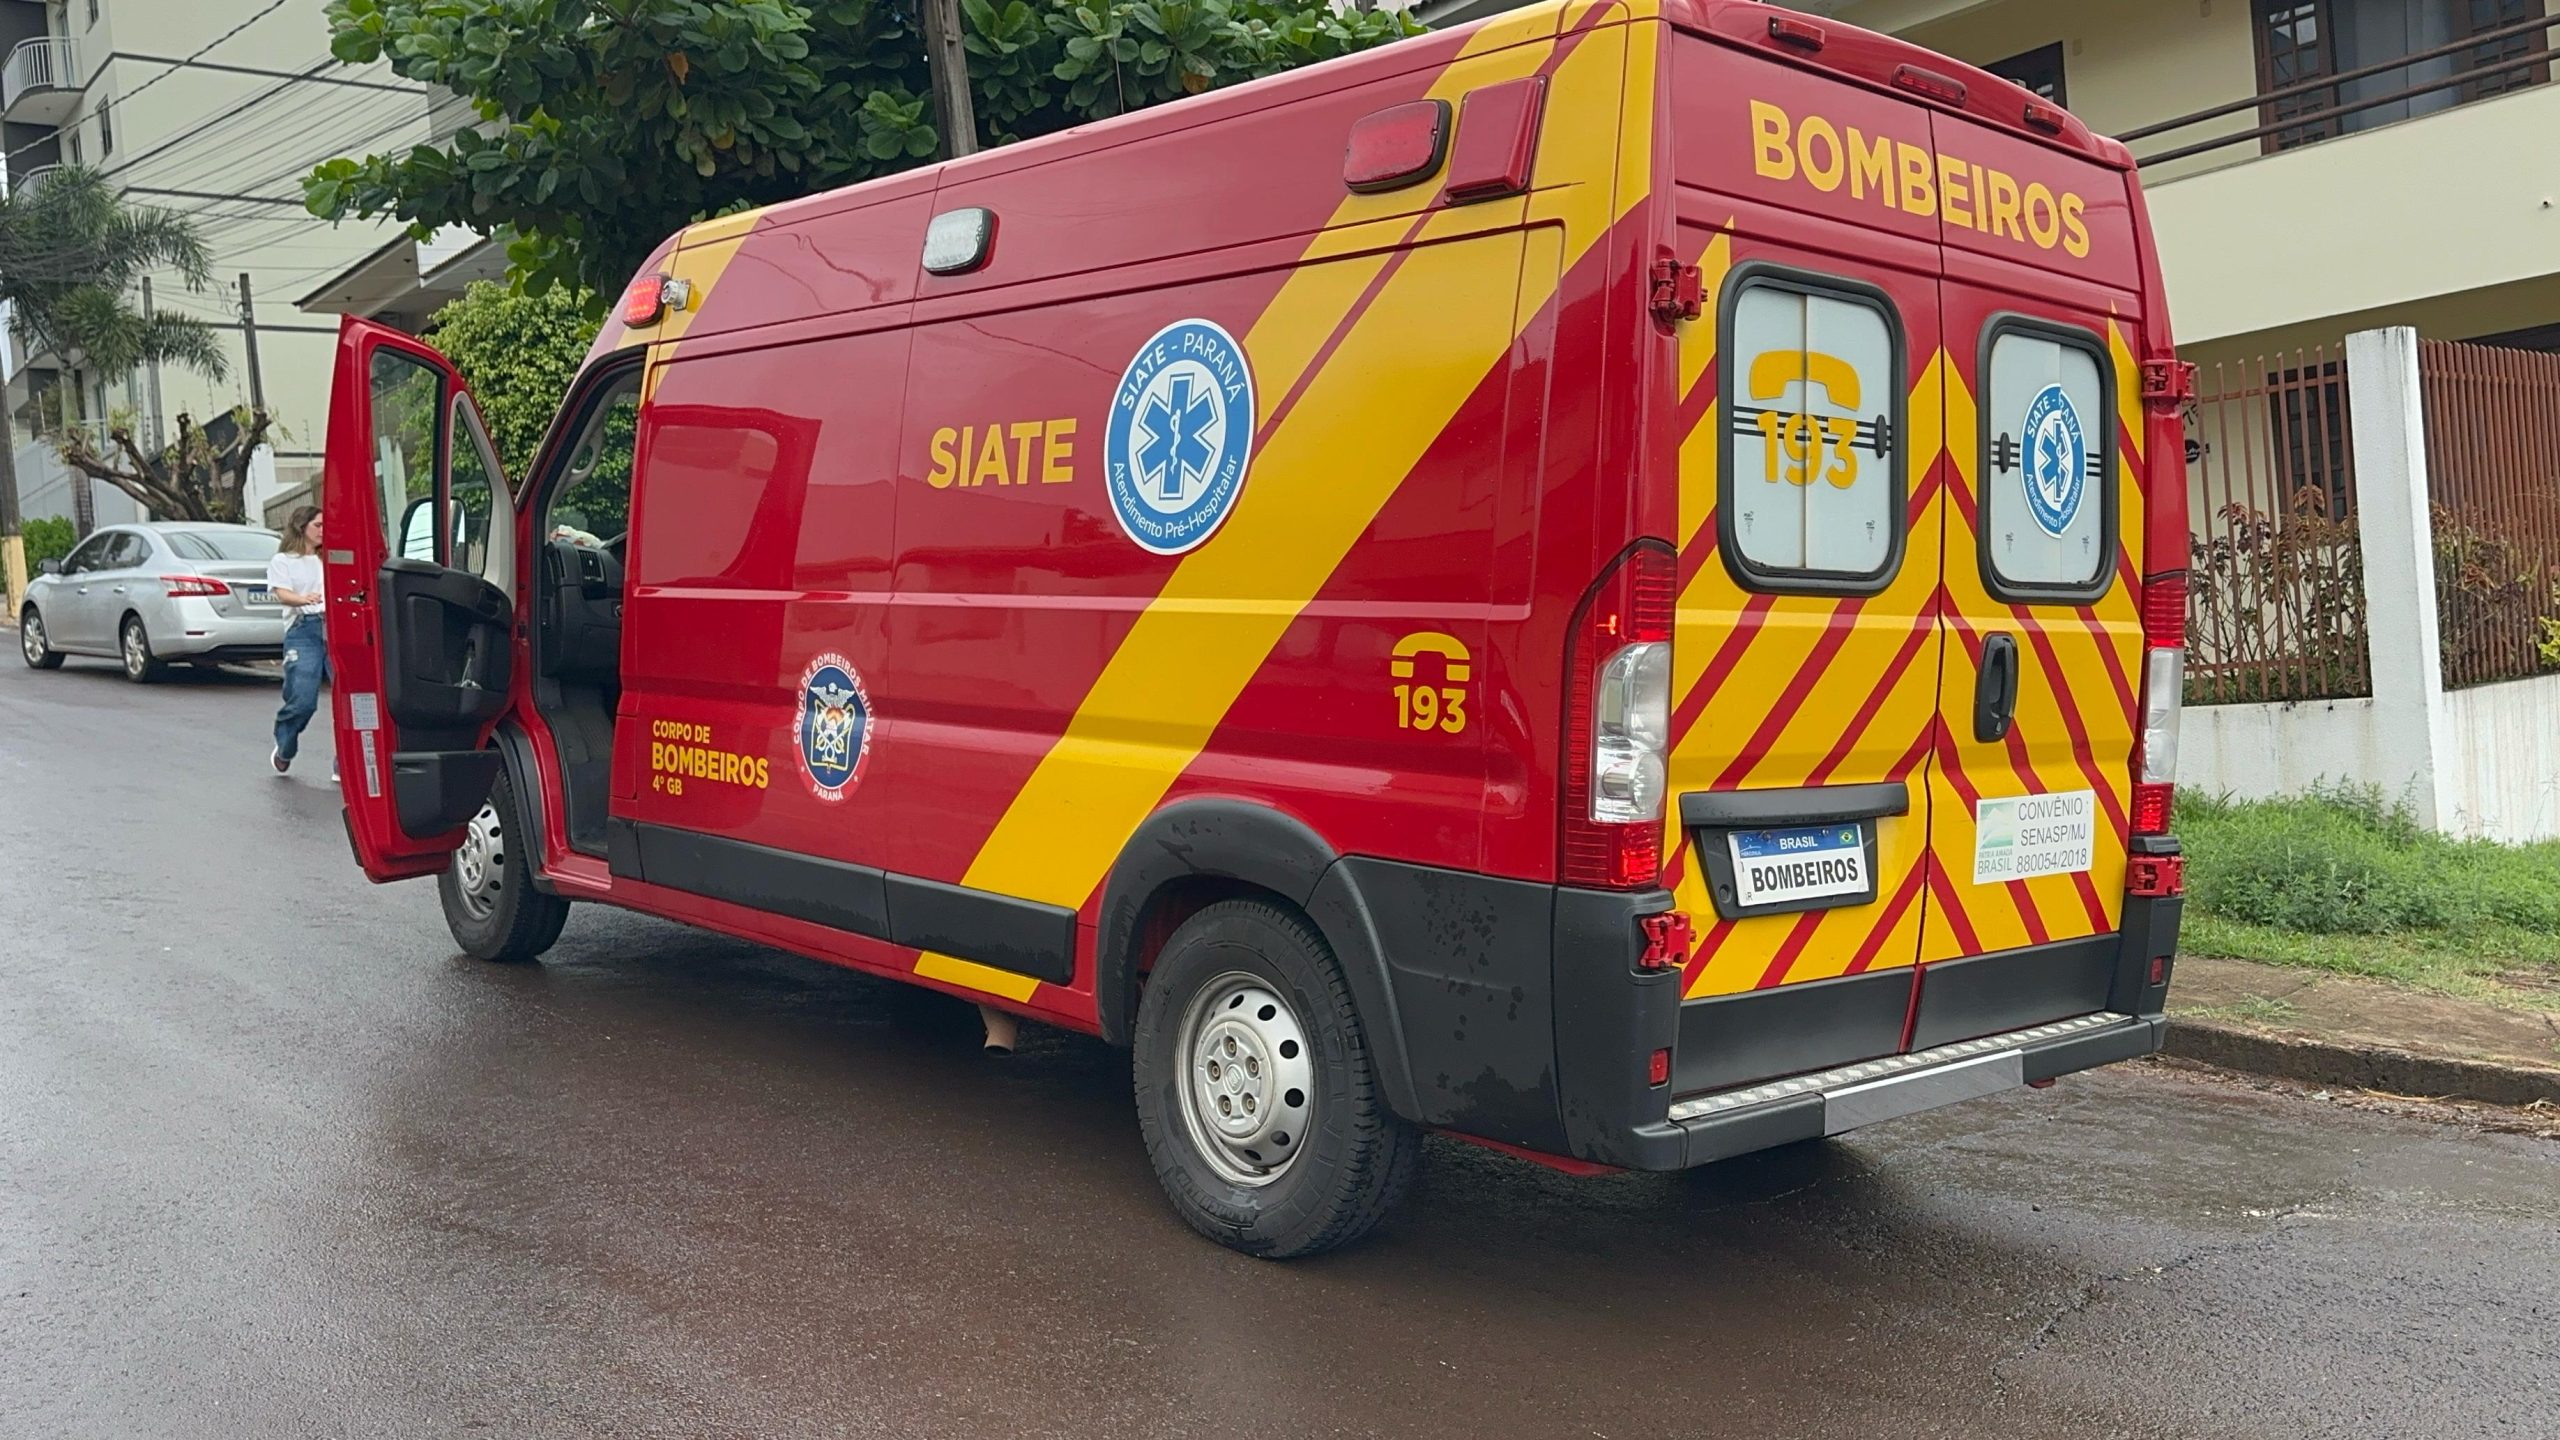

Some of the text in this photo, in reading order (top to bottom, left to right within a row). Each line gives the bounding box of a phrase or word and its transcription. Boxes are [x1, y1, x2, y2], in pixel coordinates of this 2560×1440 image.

[1750, 99, 2090, 259] BOMBEIROS
[1121, 342, 1167, 411] SIATE
[1183, 332, 1246, 404] PARANÁ
[2027, 395, 2051, 439] SIATE
[927, 418, 1077, 489] SIATE
[1757, 410, 1859, 490] 193
[1113, 454, 1237, 539] Atendimento Pré-Hospitalar
[2026, 473, 2058, 528] Atendimento
[793, 652, 875, 756] CORPO DE BOMBEIROS MILITAR
[1393, 684, 1466, 734] 193
[652, 719, 711, 744] CORPO DE
[652, 741, 769, 789] BOMBEIROS
[667, 777, 683, 796] GB
[812, 783, 844, 801] PARANÁ
[2018, 796, 2083, 821] CONVÊNIO
[1779, 835, 1818, 850] BRASIL
[2020, 823, 2086, 847] SENASP/MJ
[1751, 857, 1859, 893] BOMBEIROS
[1977, 858, 2012, 875] BRASIL
[2016, 848, 2087, 874] 880054/2018
